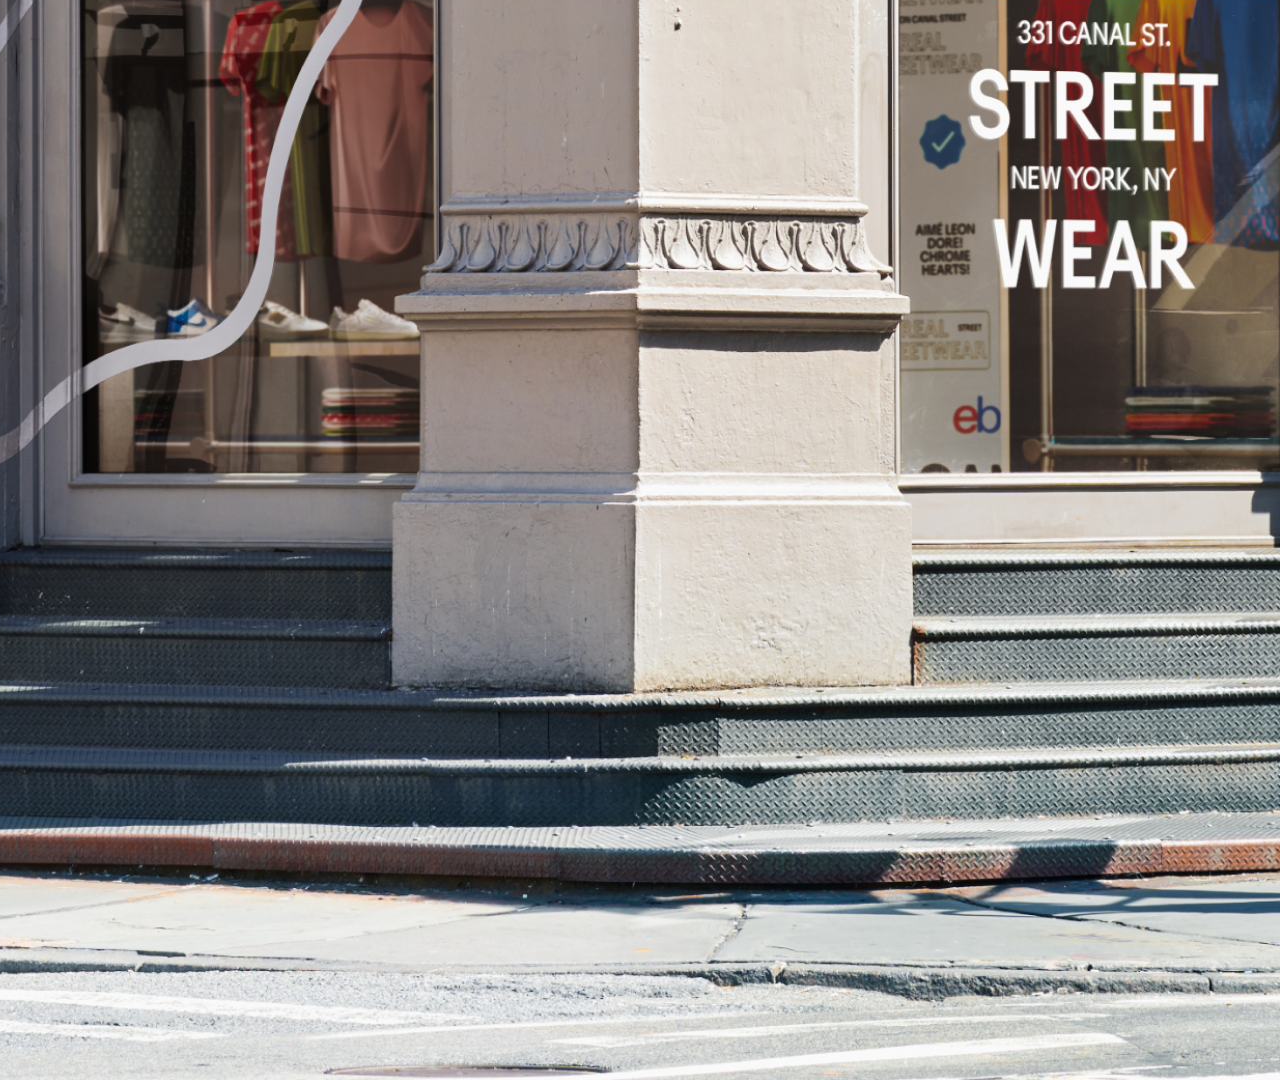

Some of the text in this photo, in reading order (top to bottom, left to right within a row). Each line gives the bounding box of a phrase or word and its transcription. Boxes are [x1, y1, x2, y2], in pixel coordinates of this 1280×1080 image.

[1017, 20, 1171, 47] 331 CANAL ST.
[968, 69, 1219, 142] STREET
[1010, 165, 1177, 195] NEW YORK, NY
[915, 222, 976, 236] AIMÉ LEON
[920, 250, 971, 263] CHROME
[927, 237, 963, 250] DORE!
[993, 218, 1195, 290] WEAR
[921, 263, 970, 276] HEARTS!
[953, 395, 1002, 434] eb
